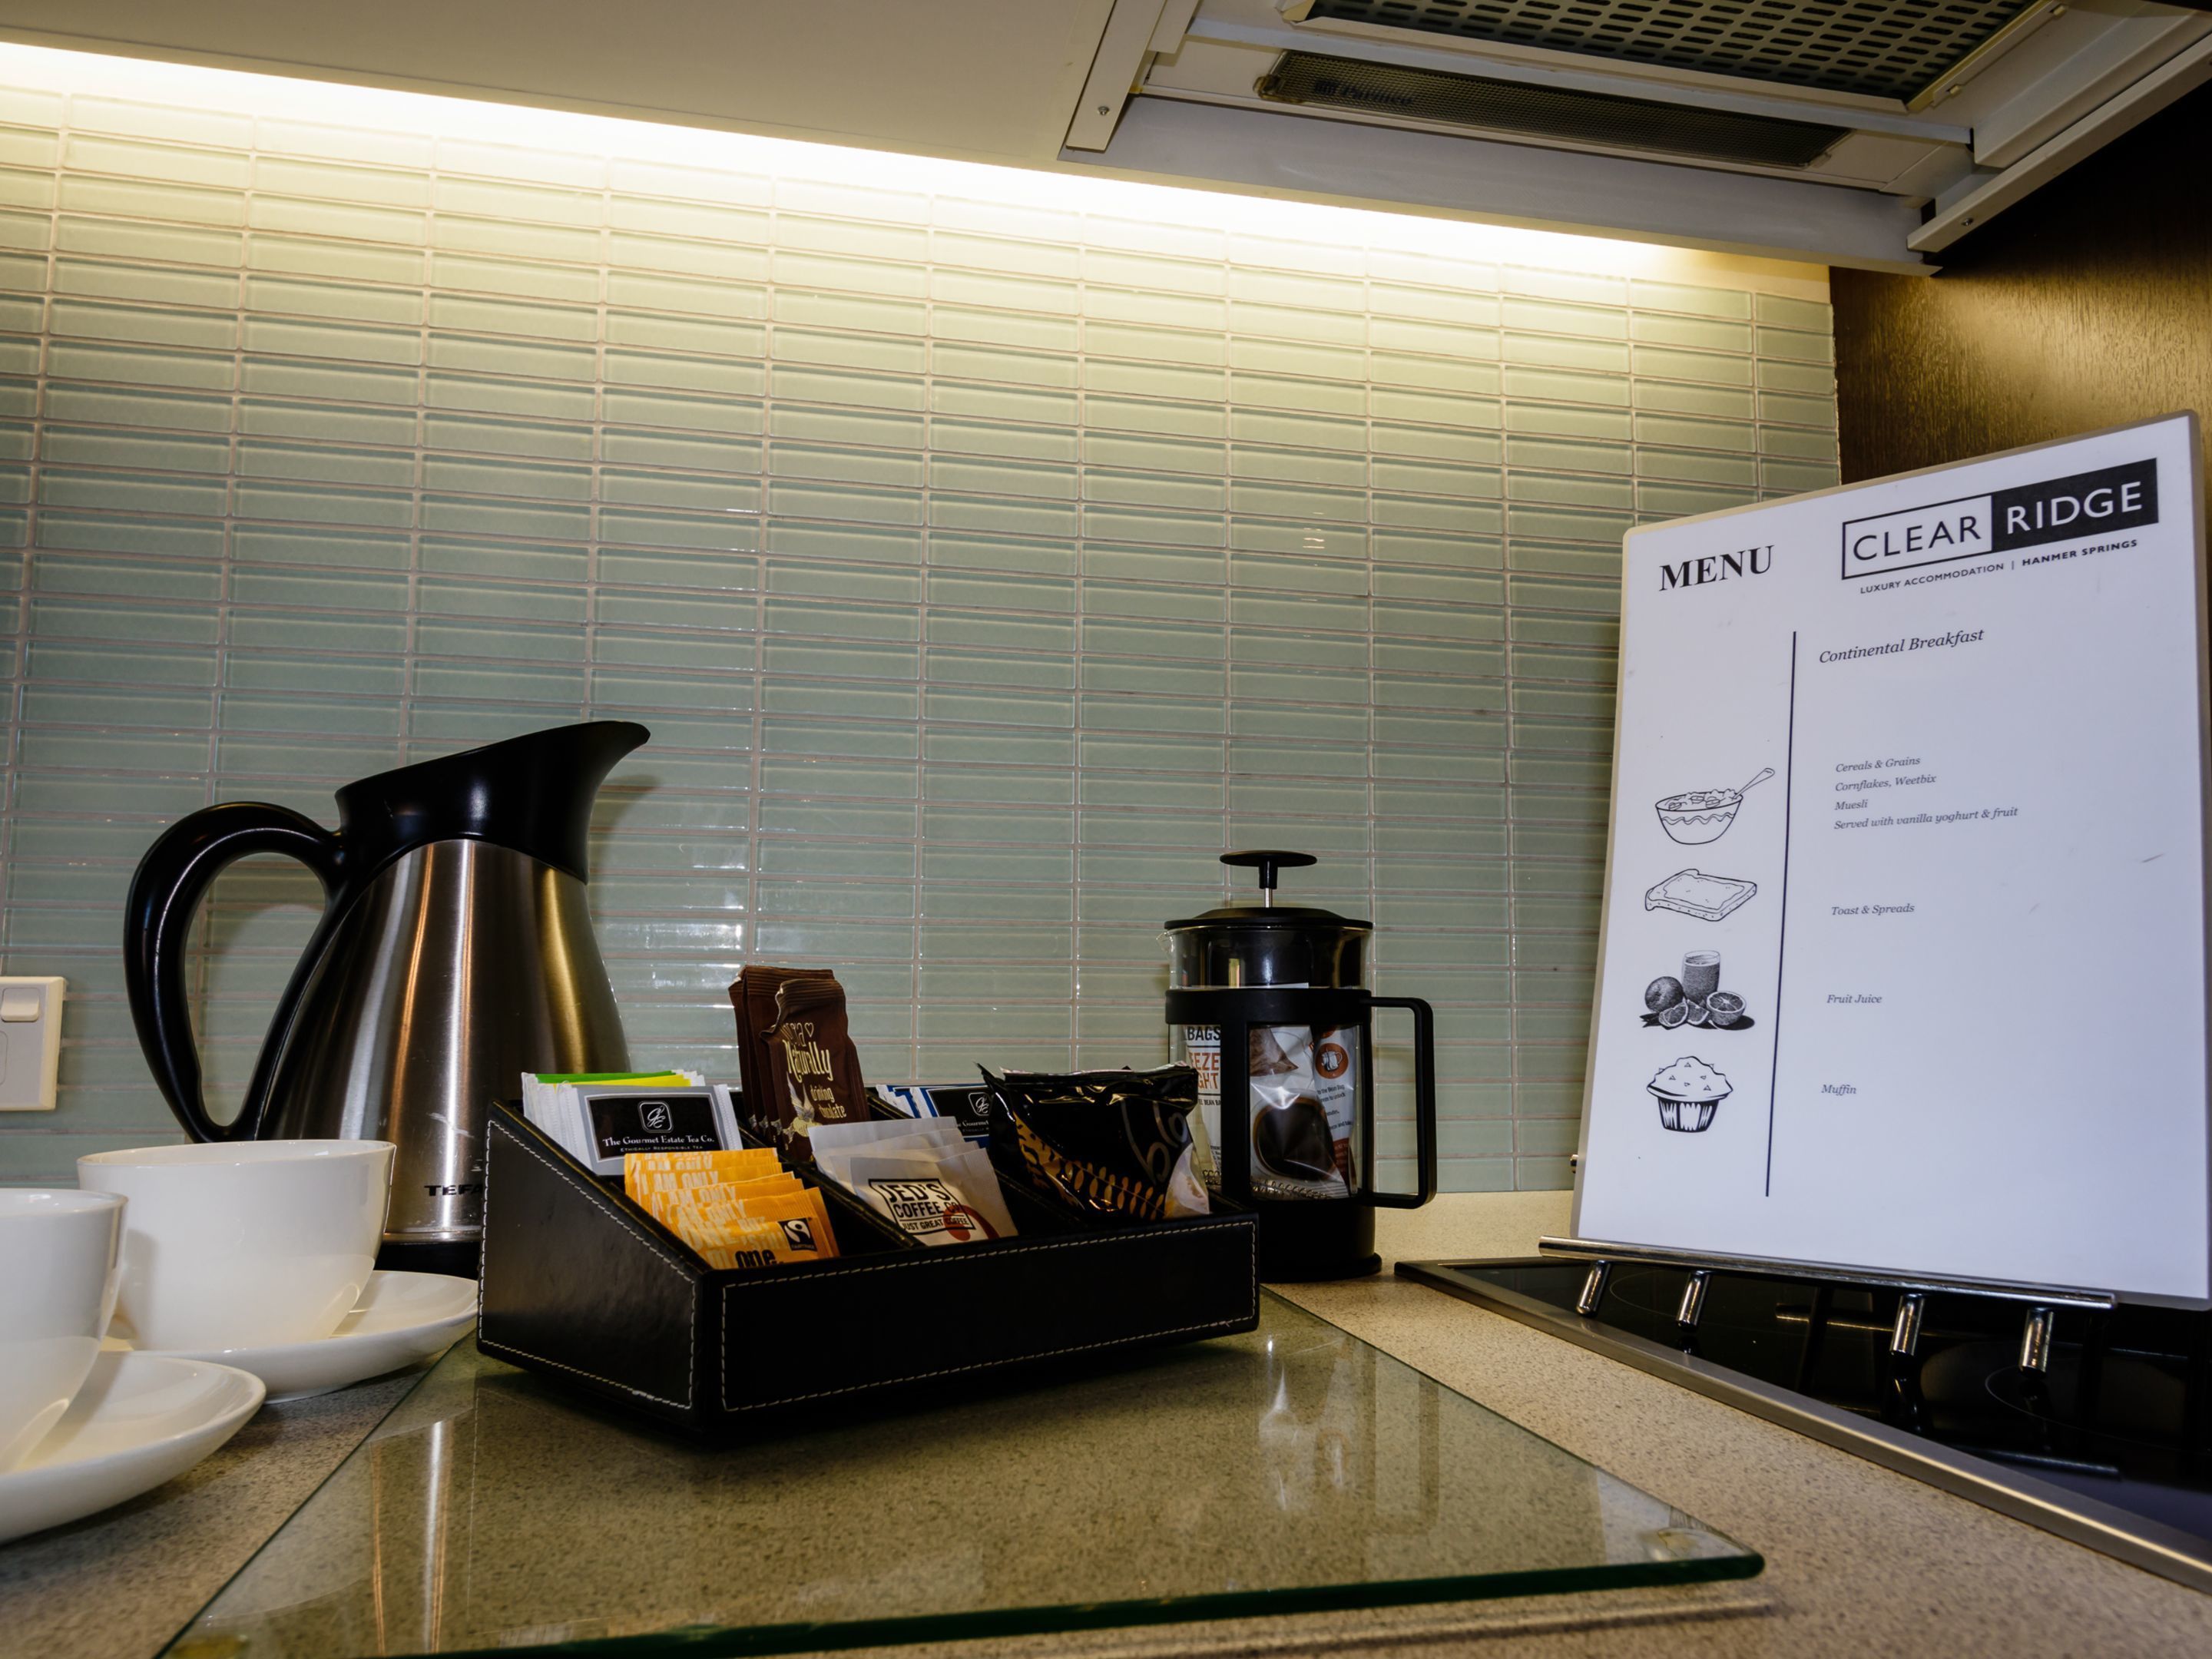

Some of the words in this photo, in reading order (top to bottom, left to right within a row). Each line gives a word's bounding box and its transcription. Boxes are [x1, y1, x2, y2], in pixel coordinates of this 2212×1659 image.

[1853, 515, 1982, 561] CLEAR
[2005, 481, 2144, 535] RIDGE
[1658, 545, 1775, 591] MENU
[1860, 580, 1901, 594] LUXURY
[1904, 562, 2005, 587] ACCOMMODATION
[2022, 549, 2078, 567] HANMER
[2081, 540, 2137, 559] SPRINGS
[1820, 638, 1906, 664] Continental
[1909, 629, 1985, 652] Breakfast
[1835, 760, 1873, 773] Cereals
[1874, 760, 1883, 769] &
[1885, 757, 1921, 768] Grains
[1835, 779, 1892, 792] Cornflakes,
[1895, 774, 1936, 786] Weetbix
[1834, 799, 1868, 810] Muesli
[1834, 818, 1868, 830] Served
[1871, 816, 1894, 827] with
[1896, 813, 1932, 825] vanilla
[1936, 810, 1979, 824] yoghurt
[1981, 809, 1990, 818] &
[1992, 806, 2018, 820] fruit
[1831, 906, 1859, 916] Toast
[1861, 906, 1869, 914] &
[1873, 903, 1915, 916] Spreads
[1827, 995, 1853, 1004] Fruit
[1854, 995, 1882, 1004] Juice
[1187, 1026, 1221, 1041] BAGS
[785, 1039, 834, 1084] Naturally
[1821, 1084, 1857, 1096] Muffin
[603, 1136, 621, 1147] The
[622, 1135, 659, 1144] Gourmet
[661, 1134, 684, 1144] Estate
[686, 1134, 699, 1143] Tea
[700, 1134, 714, 1143] Co.
[424, 1184, 483, 1197] TEFA
[879, 1184, 951, 1203] JED'S
[893, 1201, 944, 1218] COFFEE
[902, 1222, 920, 1230] JUST
[919, 1219, 943, 1229] GREAT
[945, 1217, 969, 1226] COFFEE
